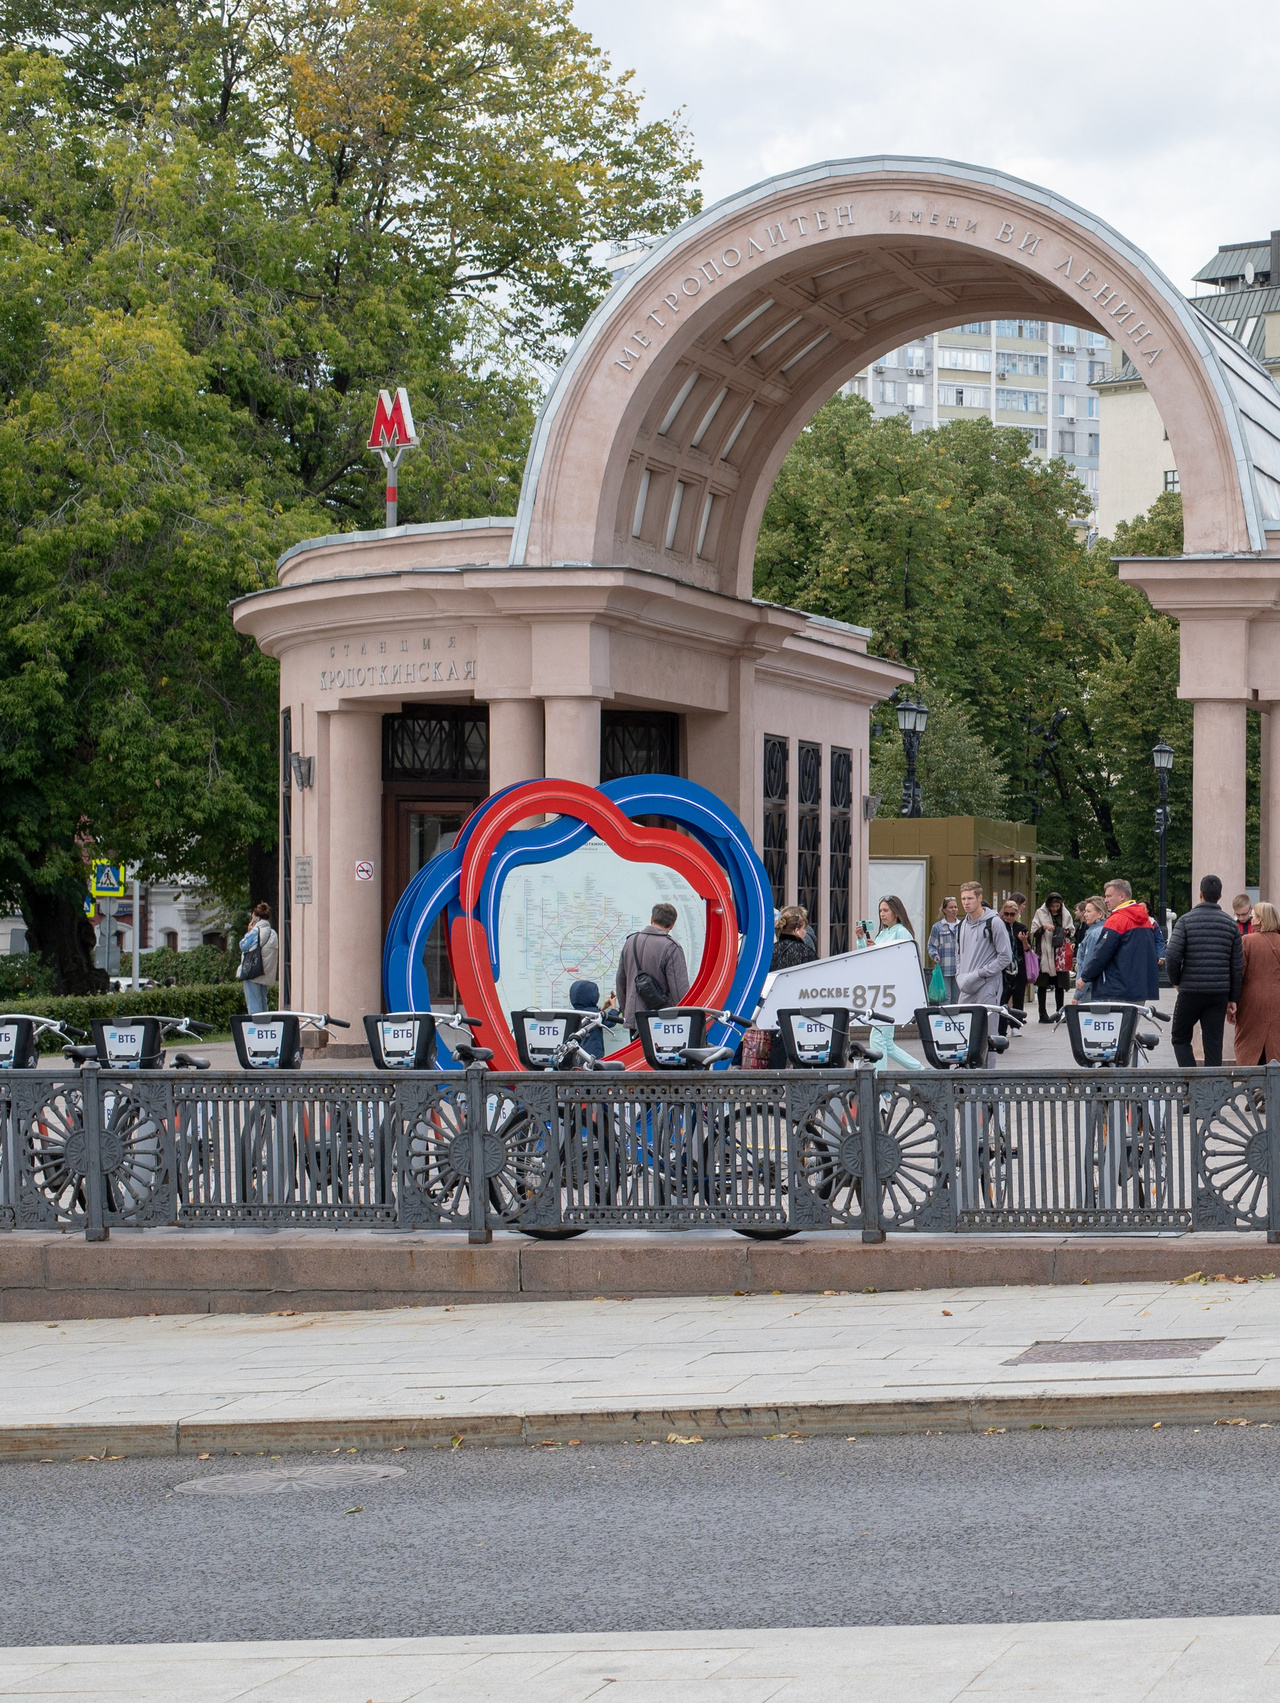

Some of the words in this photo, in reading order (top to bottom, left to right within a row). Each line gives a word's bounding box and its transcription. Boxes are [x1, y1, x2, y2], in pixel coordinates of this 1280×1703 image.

[613, 204, 855, 374] МЕТРОПОЛИТЕН
[889, 209, 978, 233] ИМЕНИ
[1053, 254, 1164, 368] ЛЕНИНА
[330, 636, 456, 658] СТАНЦИЯ
[320, 659, 477, 691] КРОПОТКИНСКАЯ
[798, 987, 850, 1000] МОСКВЕ
[852, 984, 897, 1009] 875
[539, 1026, 559, 1036] ВТБ
[663, 1024, 684, 1034] ВТБ
[806, 1023, 826, 1033] ВТБ
[944, 1021, 965, 1032] ВТБ
[1093, 1021, 1115, 1031] ВТБ
[0, 1033, 11, 1042] ТБ
[118, 1034, 136, 1043] ВТБ
[257, 1029, 277, 1039] ВТБ
[393, 1029, 412, 1039] ВТБ
